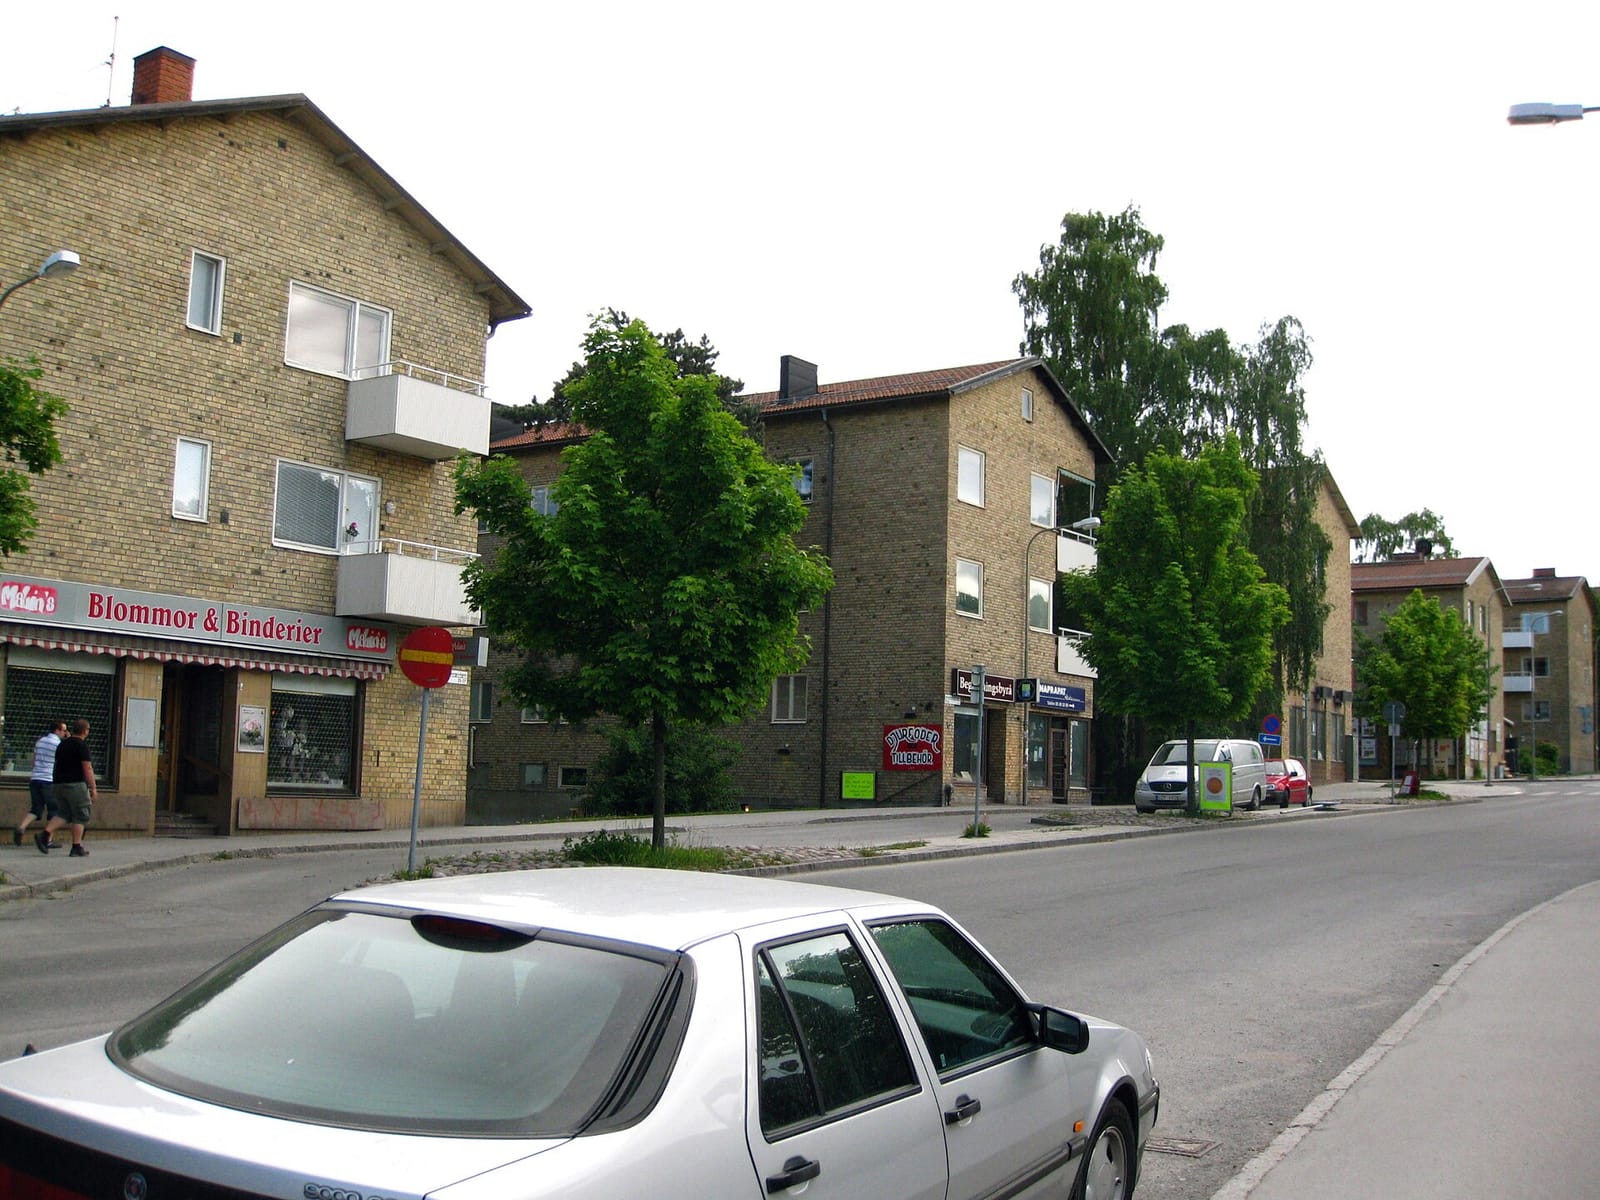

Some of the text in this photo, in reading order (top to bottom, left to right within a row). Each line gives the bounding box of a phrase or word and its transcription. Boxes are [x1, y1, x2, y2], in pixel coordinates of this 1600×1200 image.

[88, 592, 323, 645] Blommor & Binderier
[890, 749, 934, 766] TILLBEHÖR
